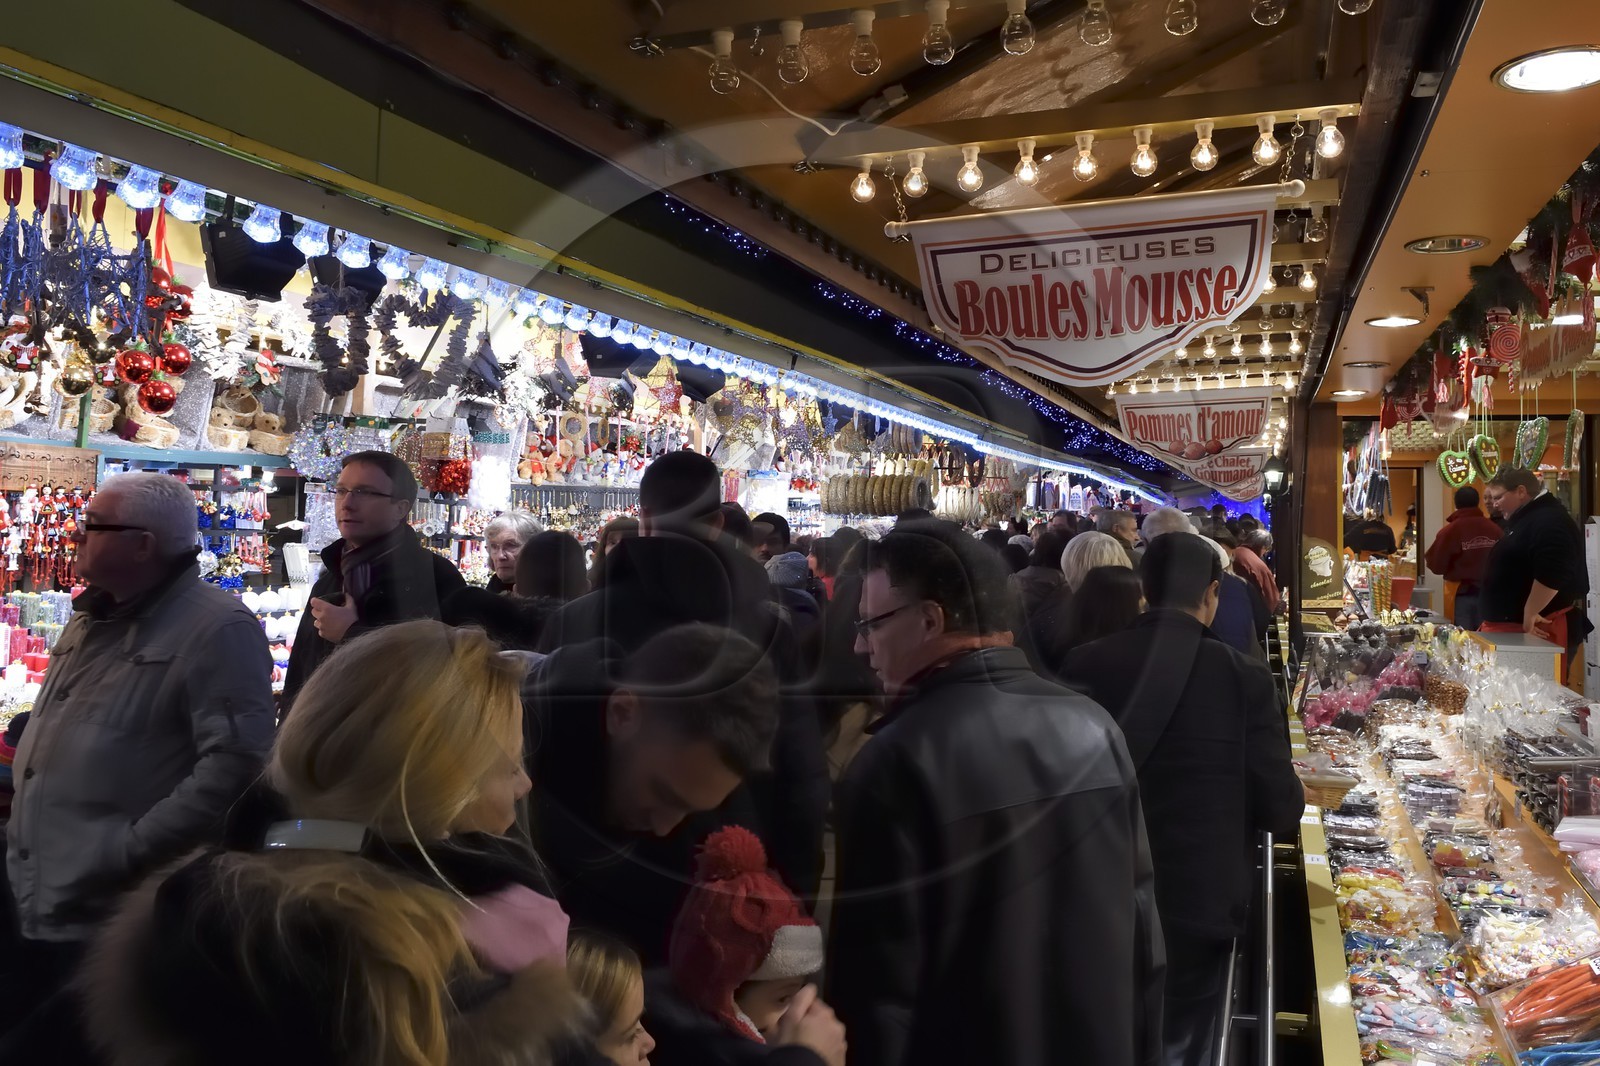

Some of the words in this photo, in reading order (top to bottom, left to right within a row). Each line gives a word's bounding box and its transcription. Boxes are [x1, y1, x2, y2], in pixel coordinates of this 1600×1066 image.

[980, 235, 1216, 274] DELICIEUSES
[954, 274, 1088, 339] Boules
[1092, 264, 1237, 337] Mousse
[1126, 410, 1192, 442] Pommes
[1197, 407, 1264, 441] d'amour
[1195, 465, 1255, 483] Gourmand
[1215, 455, 1251, 468] Chalet
